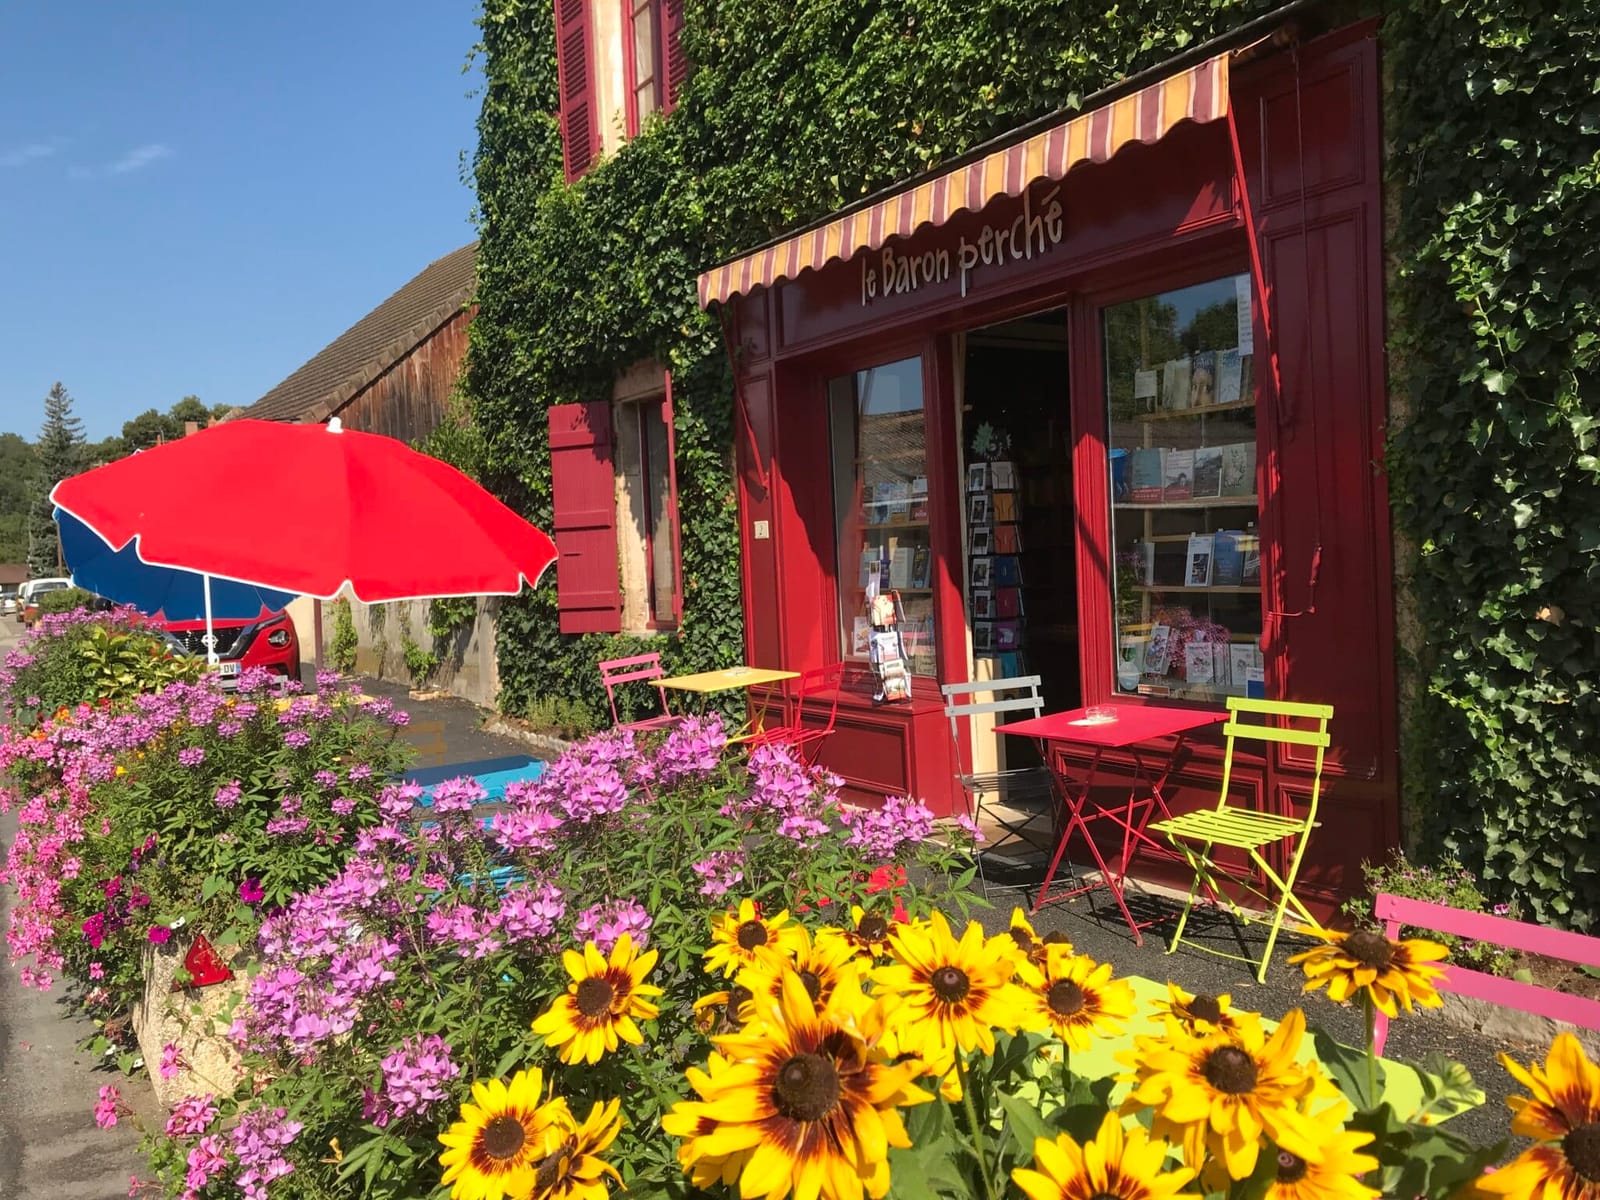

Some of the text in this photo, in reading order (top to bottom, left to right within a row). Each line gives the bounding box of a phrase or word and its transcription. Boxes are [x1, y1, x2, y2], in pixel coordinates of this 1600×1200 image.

[861, 185, 1063, 306] le Baron perché
